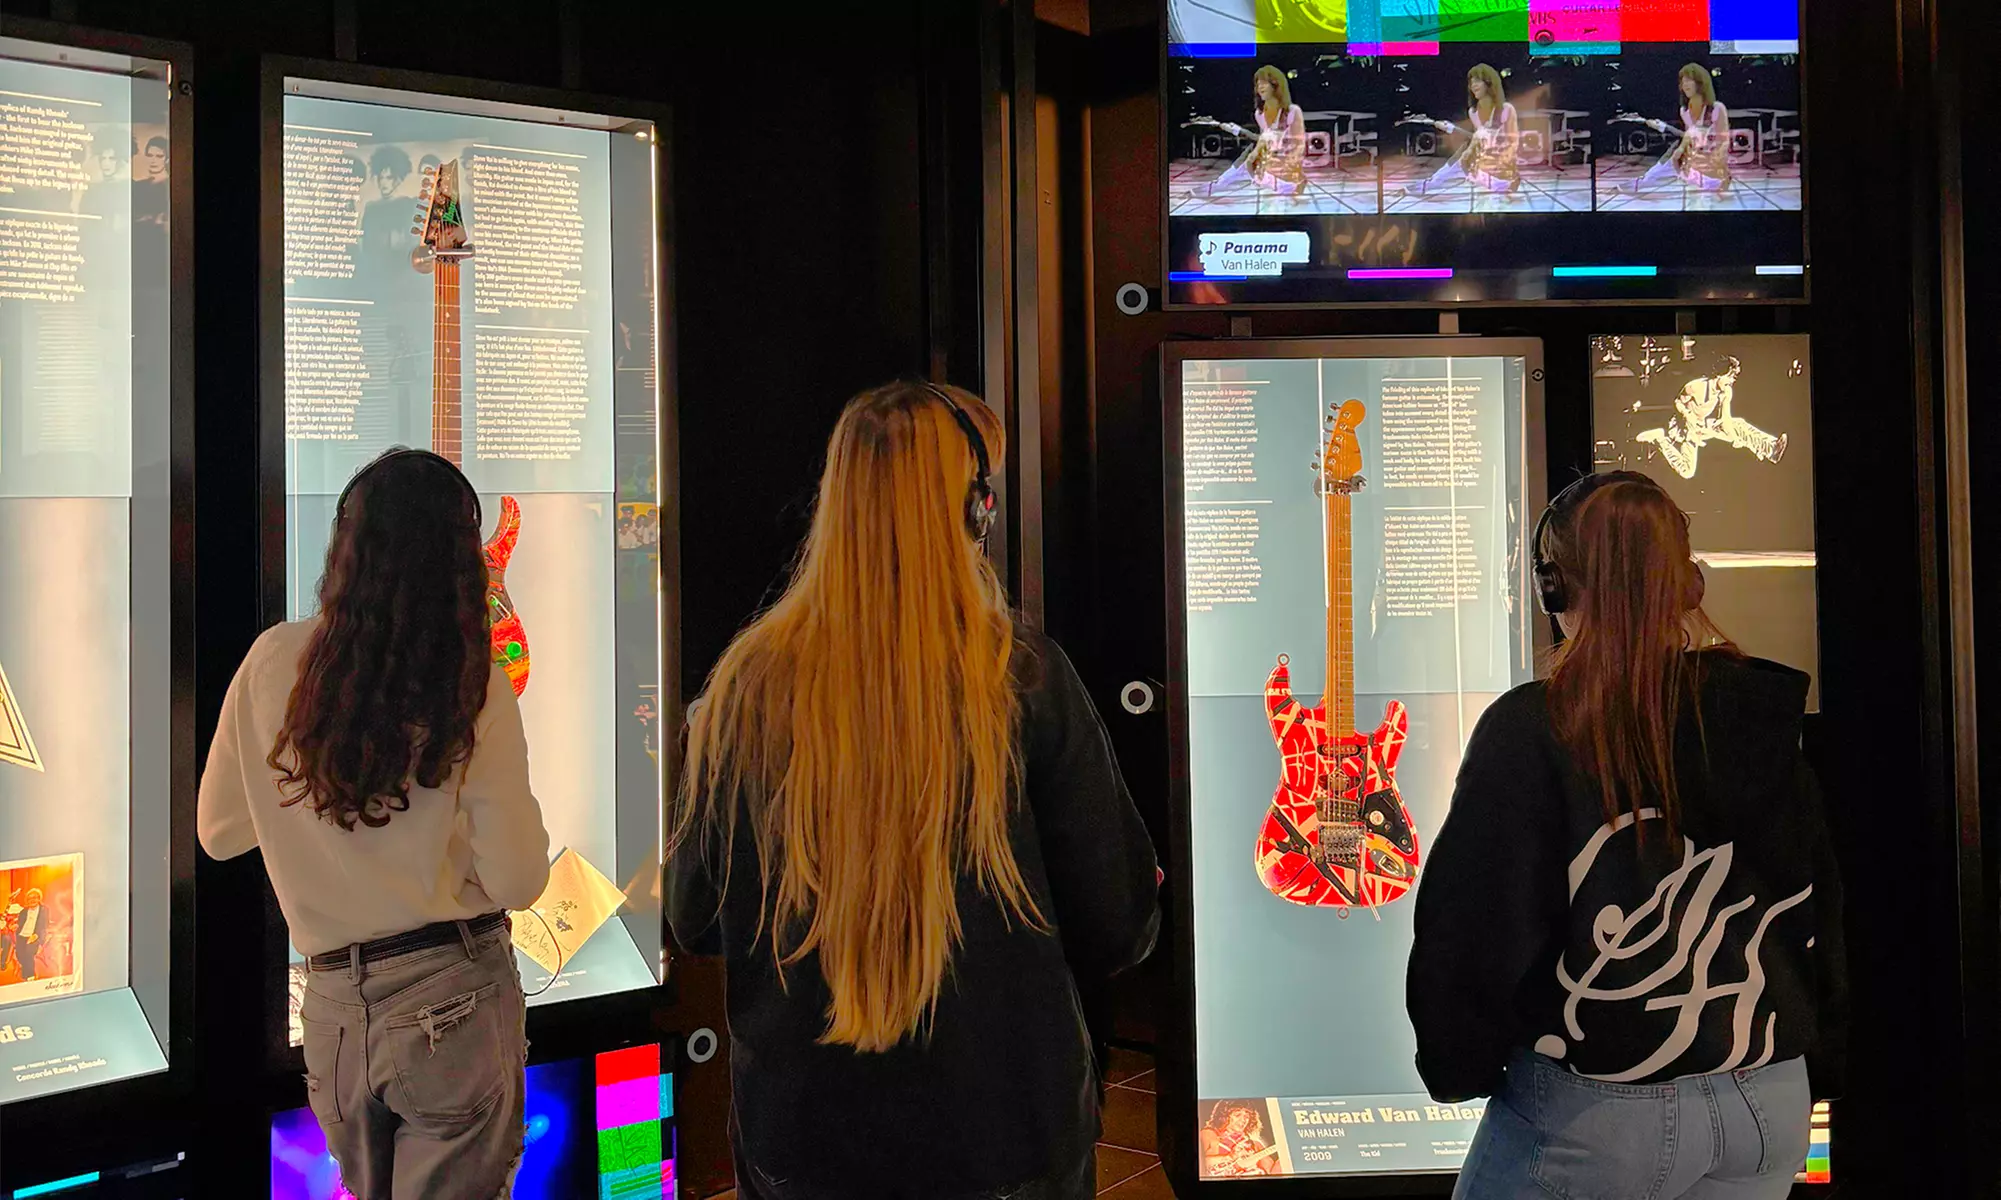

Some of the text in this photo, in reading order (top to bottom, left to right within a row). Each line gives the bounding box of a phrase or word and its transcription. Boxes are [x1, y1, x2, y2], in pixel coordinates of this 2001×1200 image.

[1224, 242, 1288, 254] Panama
[1222, 258, 1277, 270] Van Halen
[16, 1069, 53, 1082] Concorde
[1294, 1108, 1375, 1125] Edward
[1378, 1107, 1421, 1122] Van
[1298, 1128, 1345, 1138] VAN HALEN
[1304, 1152, 1332, 1161] 2009
